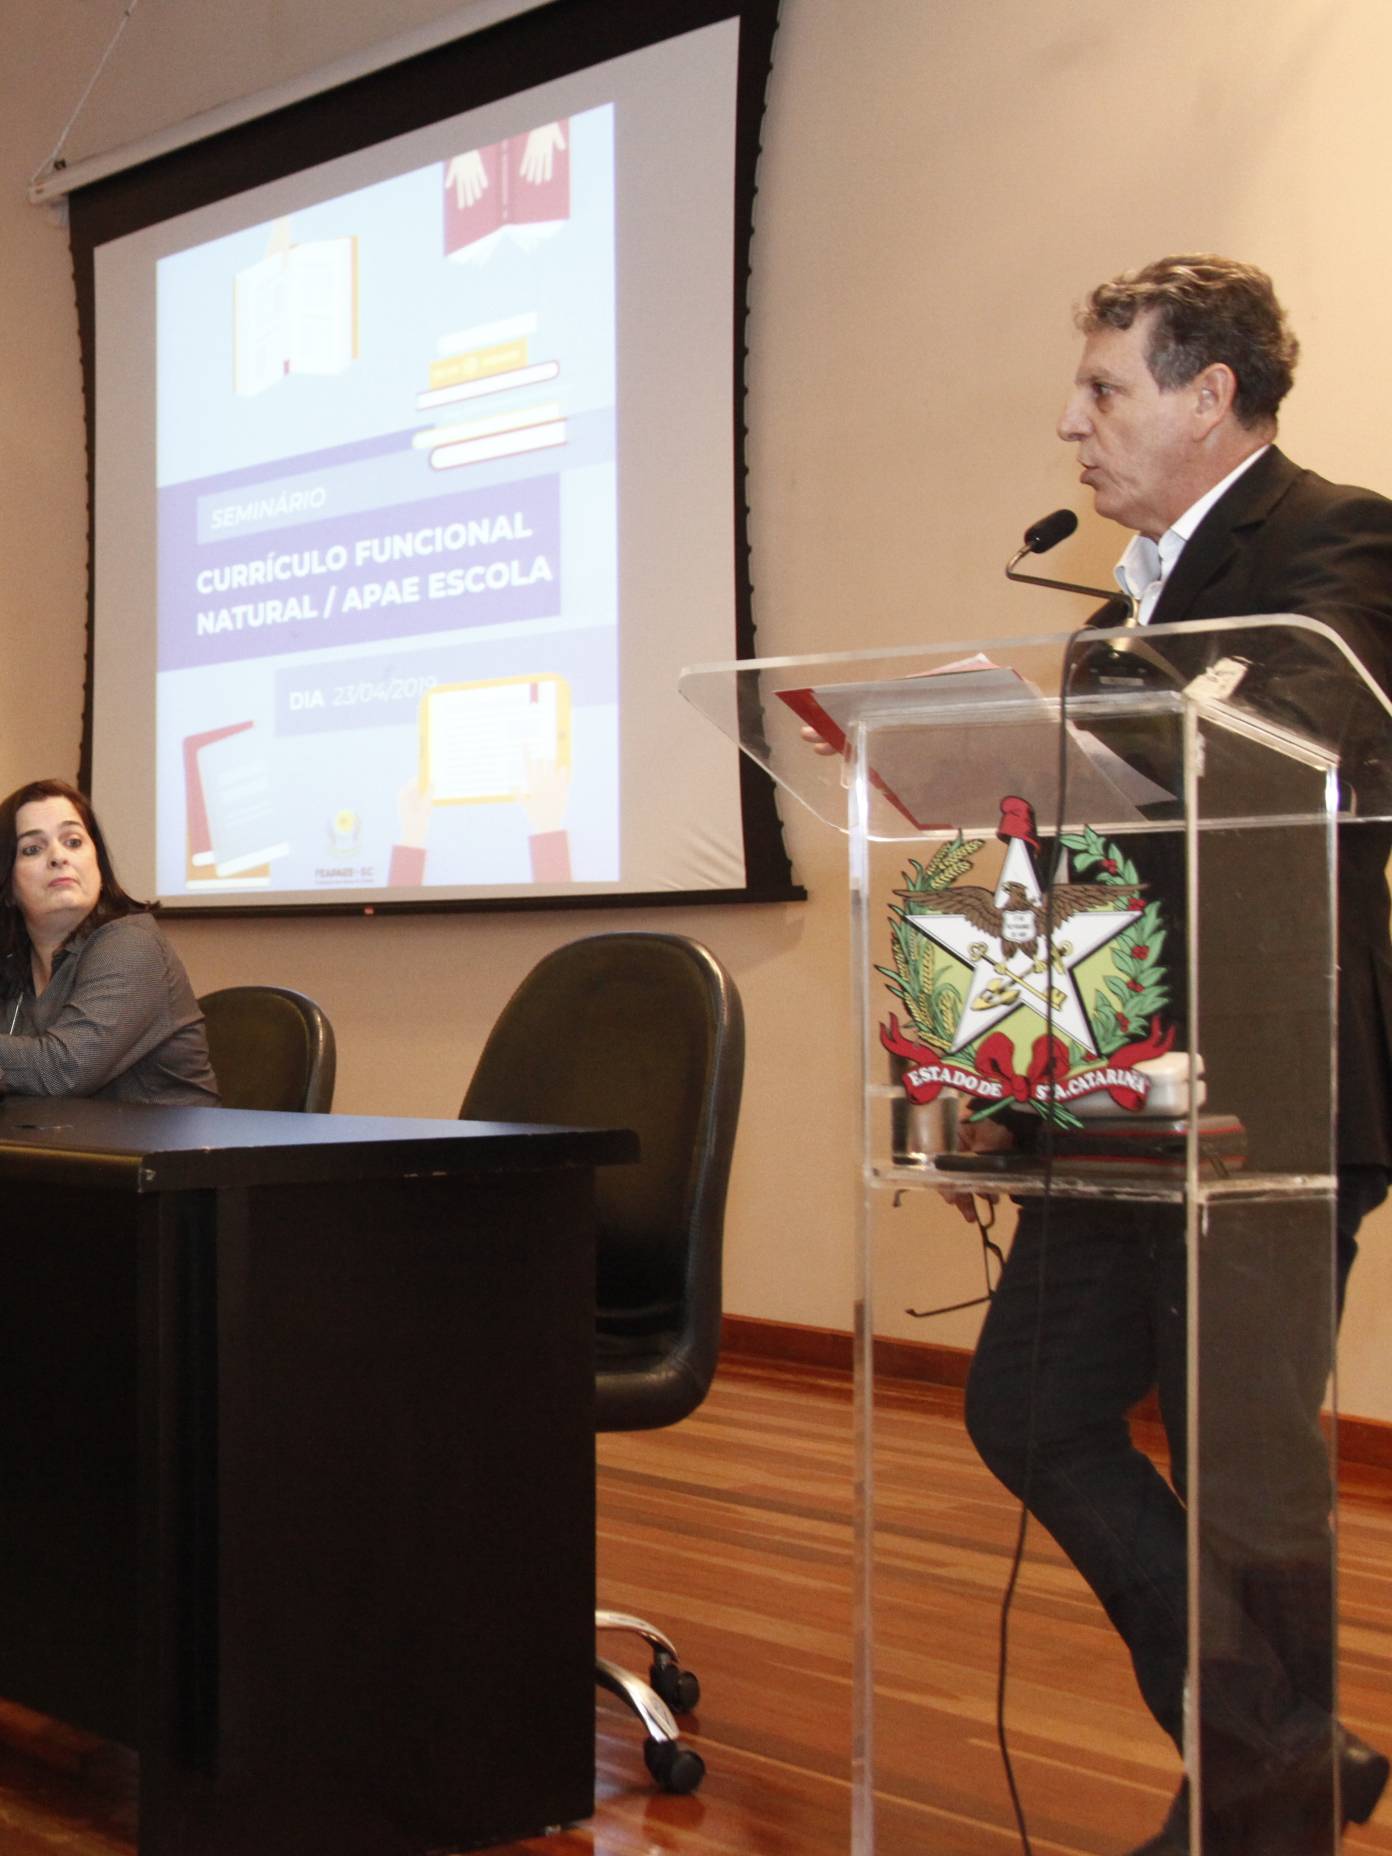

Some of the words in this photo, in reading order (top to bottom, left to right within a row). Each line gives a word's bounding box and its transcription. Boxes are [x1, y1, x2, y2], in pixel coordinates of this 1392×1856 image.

[210, 487, 326, 530] SEMINÁRIO
[196, 545, 347, 594] CURRÍCULO
[355, 512, 532, 567] FUNCIONAL
[196, 595, 317, 636] NATURAL
[323, 586, 337, 618] /
[342, 576, 420, 614] APAE
[428, 555, 553, 598] ESCOLA
[289, 690, 325, 711] DIA
[907, 1066, 979, 1090] ESTADO
[976, 1080, 1003, 1097] DE
